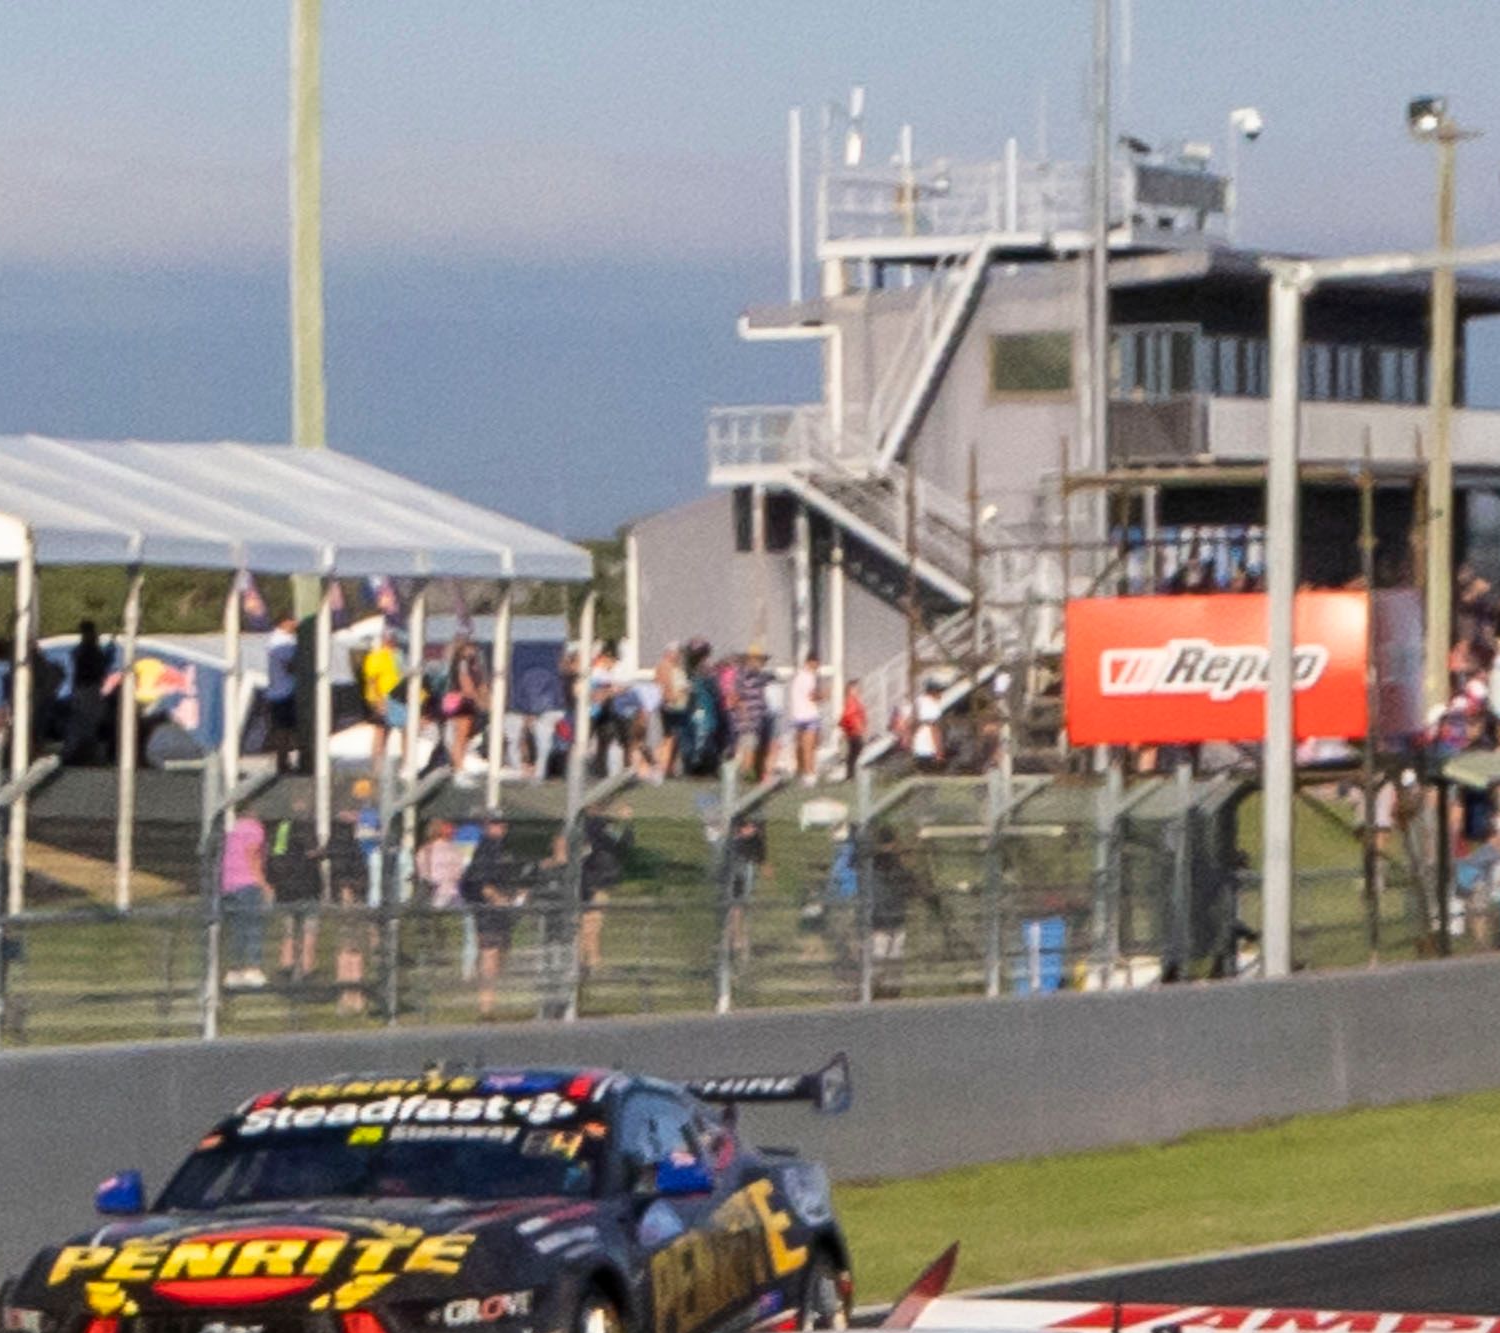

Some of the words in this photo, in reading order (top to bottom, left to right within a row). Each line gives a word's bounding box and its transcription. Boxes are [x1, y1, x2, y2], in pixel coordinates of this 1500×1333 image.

[1164, 644, 1321, 691] Repo
[237, 1093, 508, 1137] Steadfast
[47, 1233, 477, 1287] PENRITE
